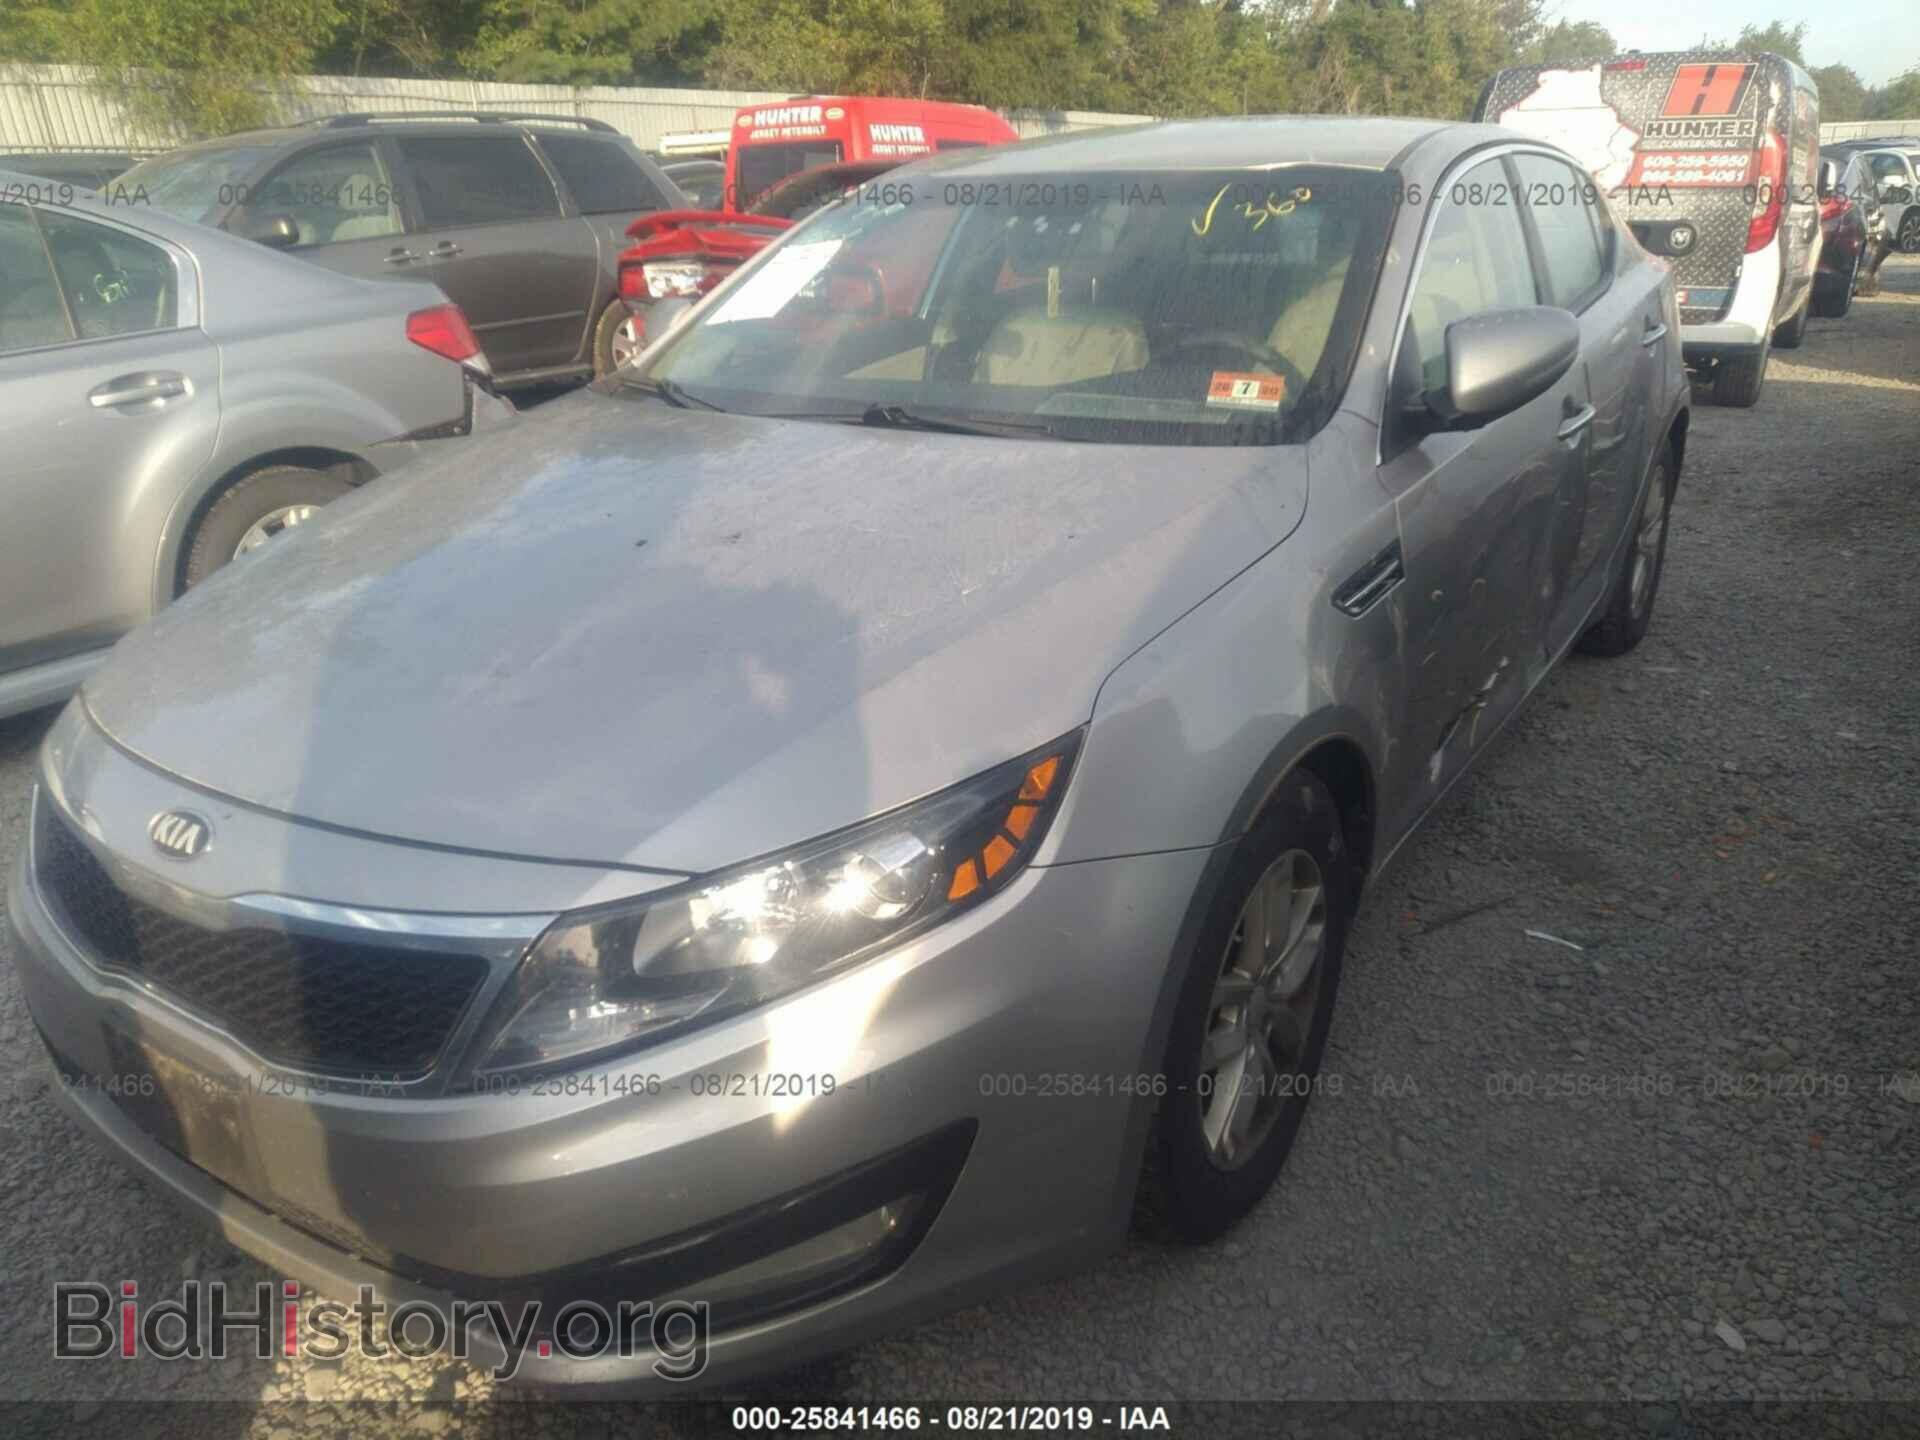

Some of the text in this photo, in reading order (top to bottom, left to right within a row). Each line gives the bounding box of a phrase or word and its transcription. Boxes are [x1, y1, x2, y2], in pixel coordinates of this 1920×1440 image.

[754, 106, 823, 126] HUNTER
[869, 124, 925, 143] HUNTER
[1645, 120, 1757, 138] HUNTER
[1241, 382, 1251, 395] 7
[153, 814, 201, 854] KIA
